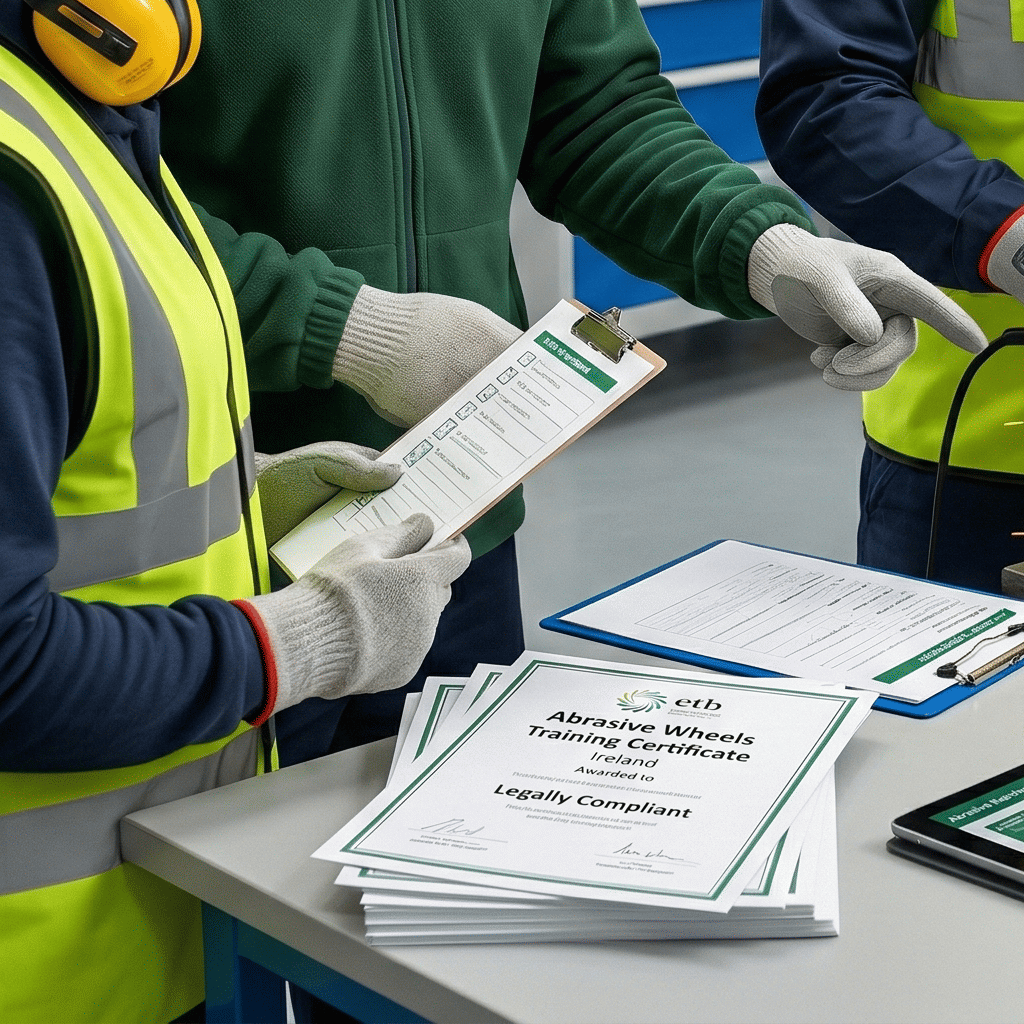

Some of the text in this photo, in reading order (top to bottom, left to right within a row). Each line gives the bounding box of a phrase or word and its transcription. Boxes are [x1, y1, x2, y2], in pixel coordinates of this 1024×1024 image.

[674, 697, 722, 712] etb
[546, 710, 656, 734] Abrasive
[663, 724, 756, 746] Wheels
[527, 725, 751, 763] Training Certificate
[590, 751, 660, 769] Ireland
[573, 765, 655, 783] Awarded to
[493, 783, 573, 806] Legally
[575, 795, 693, 820] Compliant
